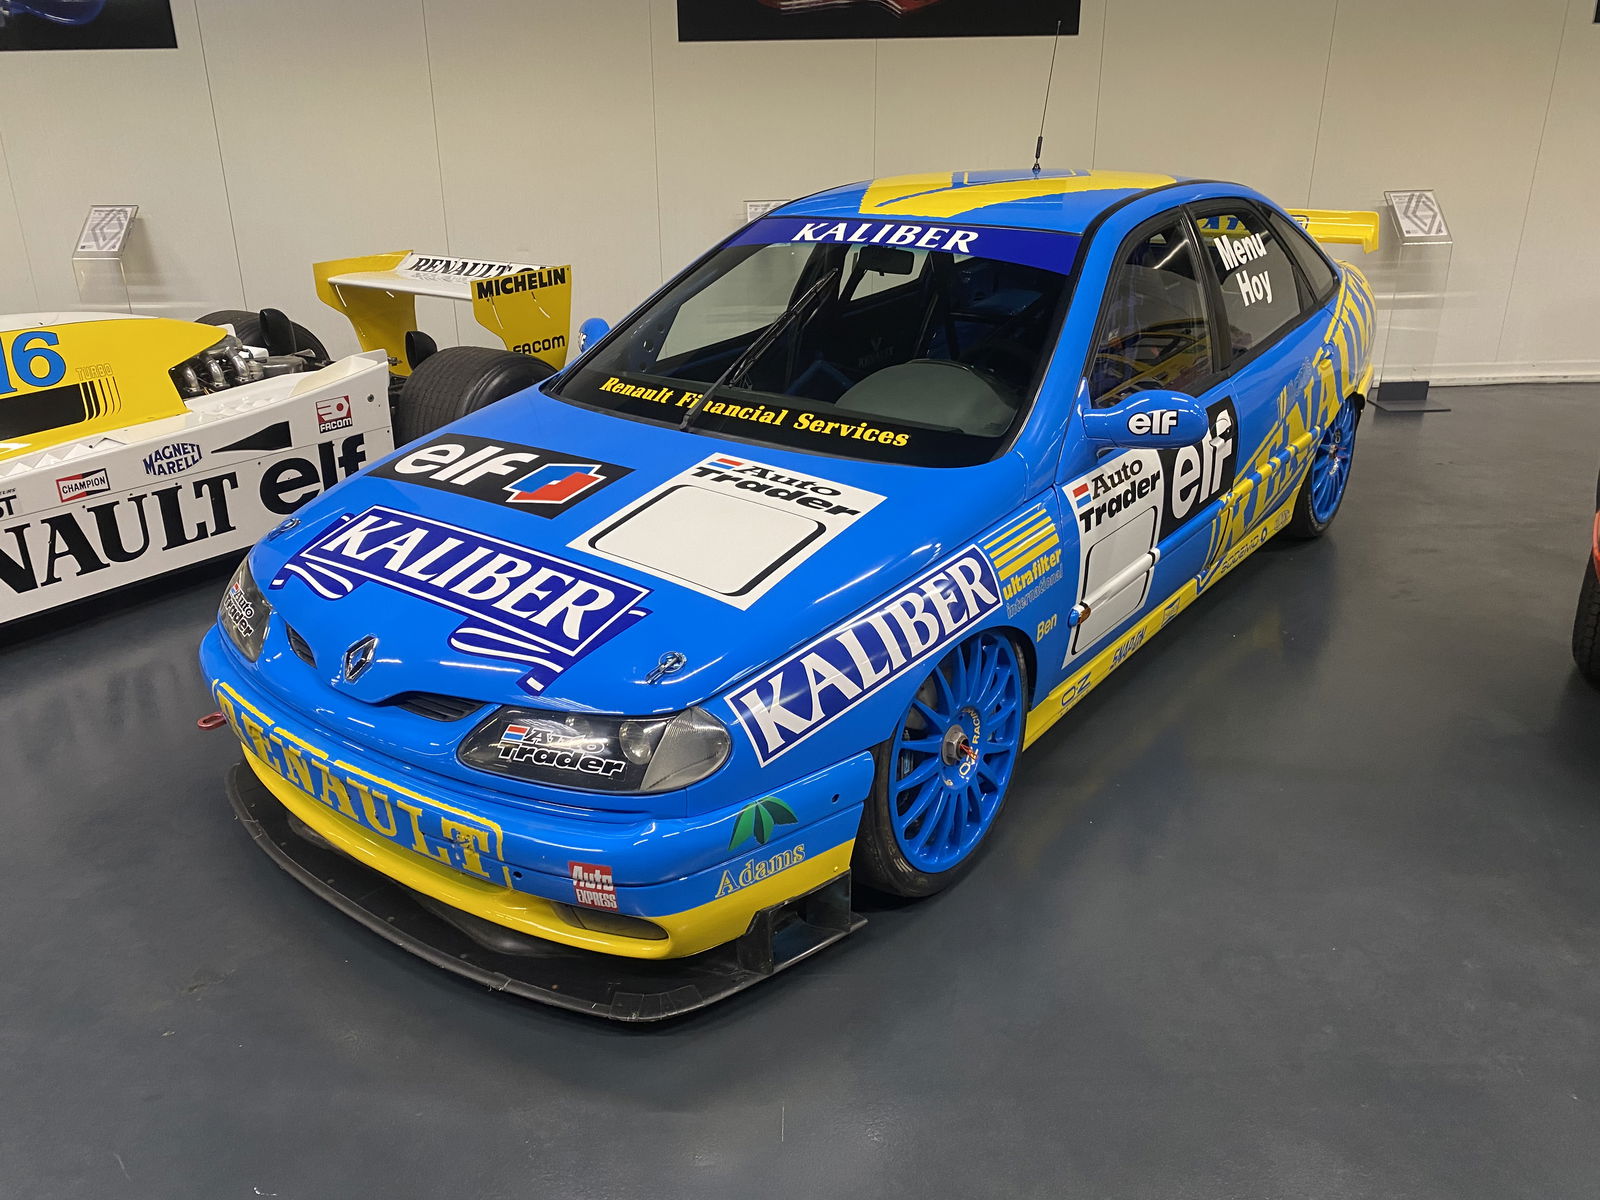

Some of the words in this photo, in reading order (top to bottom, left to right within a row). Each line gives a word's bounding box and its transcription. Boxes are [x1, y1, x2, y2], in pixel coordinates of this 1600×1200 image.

[791, 223, 979, 253] KALIBER
[1213, 233, 1267, 271] Menu
[408, 257, 512, 278] RENAULT
[477, 268, 566, 299] MICHELIN
[1236, 270, 1273, 307] Hoy
[513, 335, 565, 355] FACOM
[75, 363, 113, 381] TURBO
[320, 417, 352, 433] FACOM
[599, 377, 674, 404] Renault
[793, 413, 911, 447] Services
[1127, 410, 1179, 435] elf
[143, 443, 203, 463] MAGNETI
[143, 453, 203, 475] MARELLI
[394, 443, 540, 487] elf
[1171, 409, 1233, 519] elf
[62, 476, 106, 495] CHAMPION
[259, 433, 366, 515] elf
[691, 466, 861, 516] Trader
[733, 465, 842, 496] Auto
[1091, 459, 1143, 500] Auto
[1079, 470, 1161, 533] Trader
[321, 516, 615, 640] KALIBER
[1002, 549, 1062, 601] ultrafilter
[1006, 563, 1063, 620] international
[224, 591, 254, 637] Trader
[233, 588, 254, 619] Auto
[1036, 613, 1057, 642] Ben
[740, 557, 997, 753] KALIBER
[498, 740, 626, 776] Trader
[522, 728, 605, 753] Auto
[217, 688, 491, 878] RENAULT
[573, 865, 613, 891] Auto
[715, 843, 806, 899] Adams
[576, 889, 618, 909] EXPRESS
